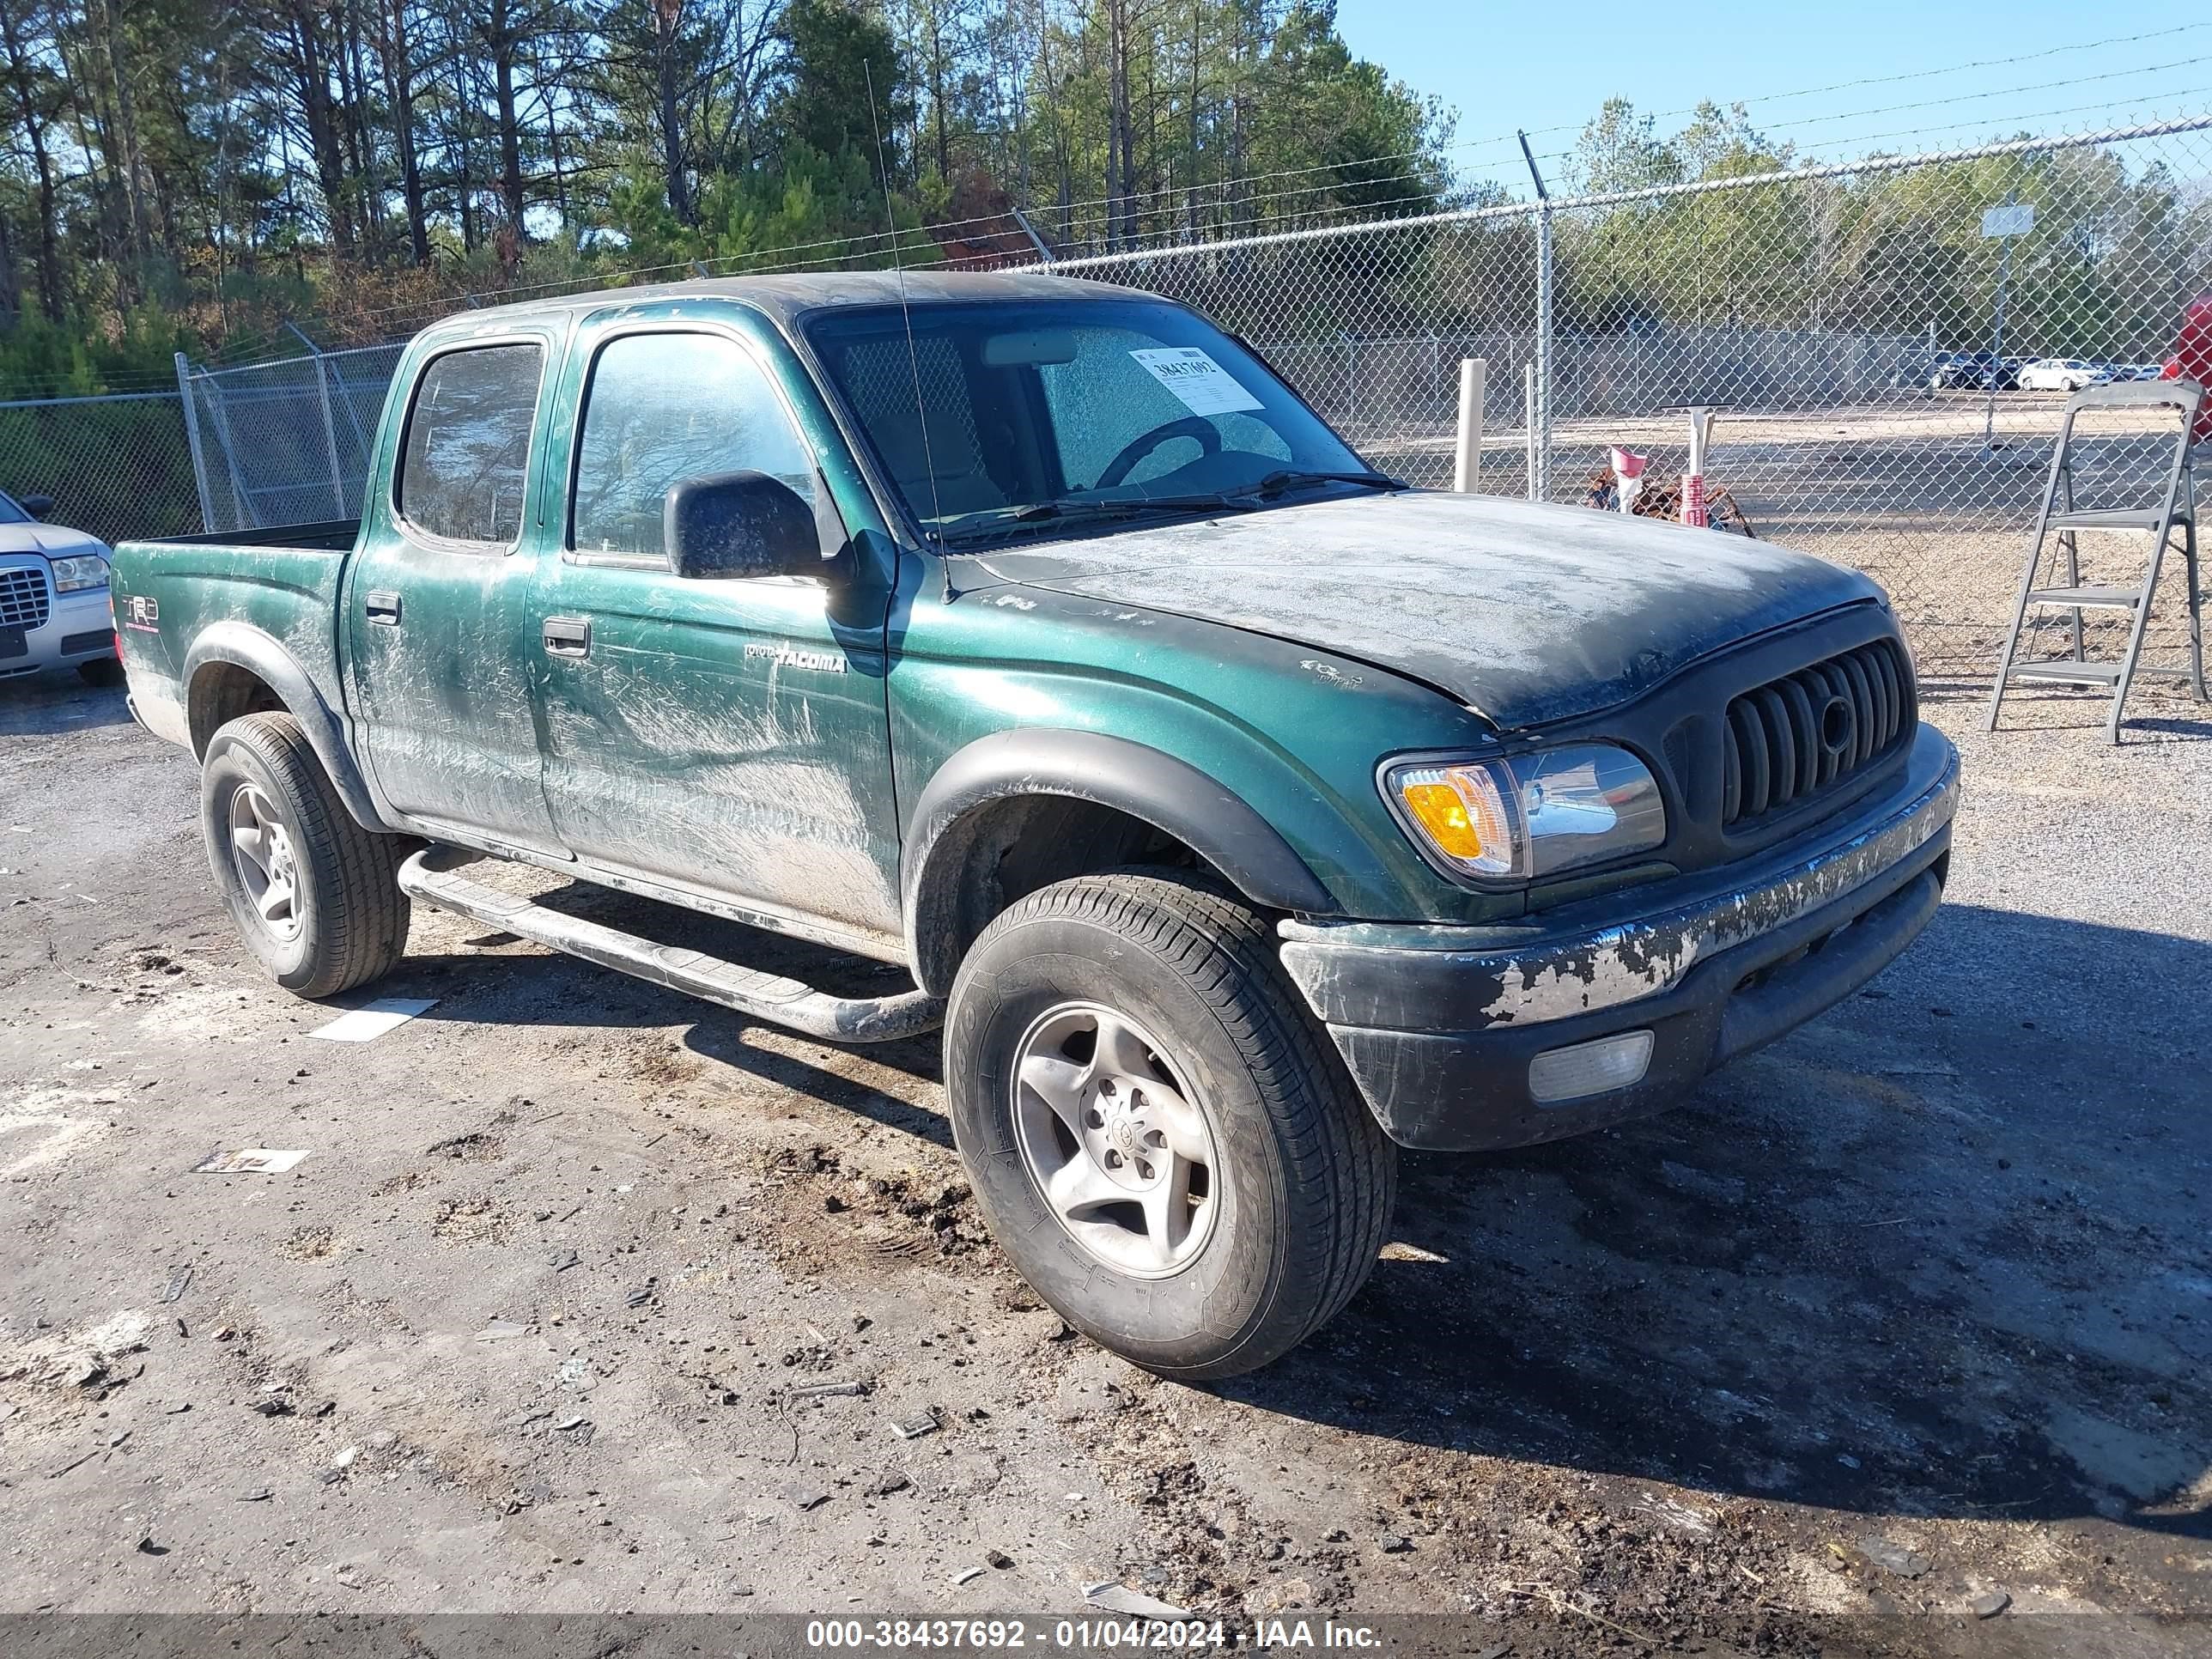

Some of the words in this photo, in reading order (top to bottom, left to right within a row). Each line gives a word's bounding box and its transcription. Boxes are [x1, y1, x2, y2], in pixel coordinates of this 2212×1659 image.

[1153, 361, 1217, 378] 38437692
[123, 594, 159, 625] TRD
[744, 644, 776, 659] TOYOTA
[776, 648, 848, 673] TACOMA
